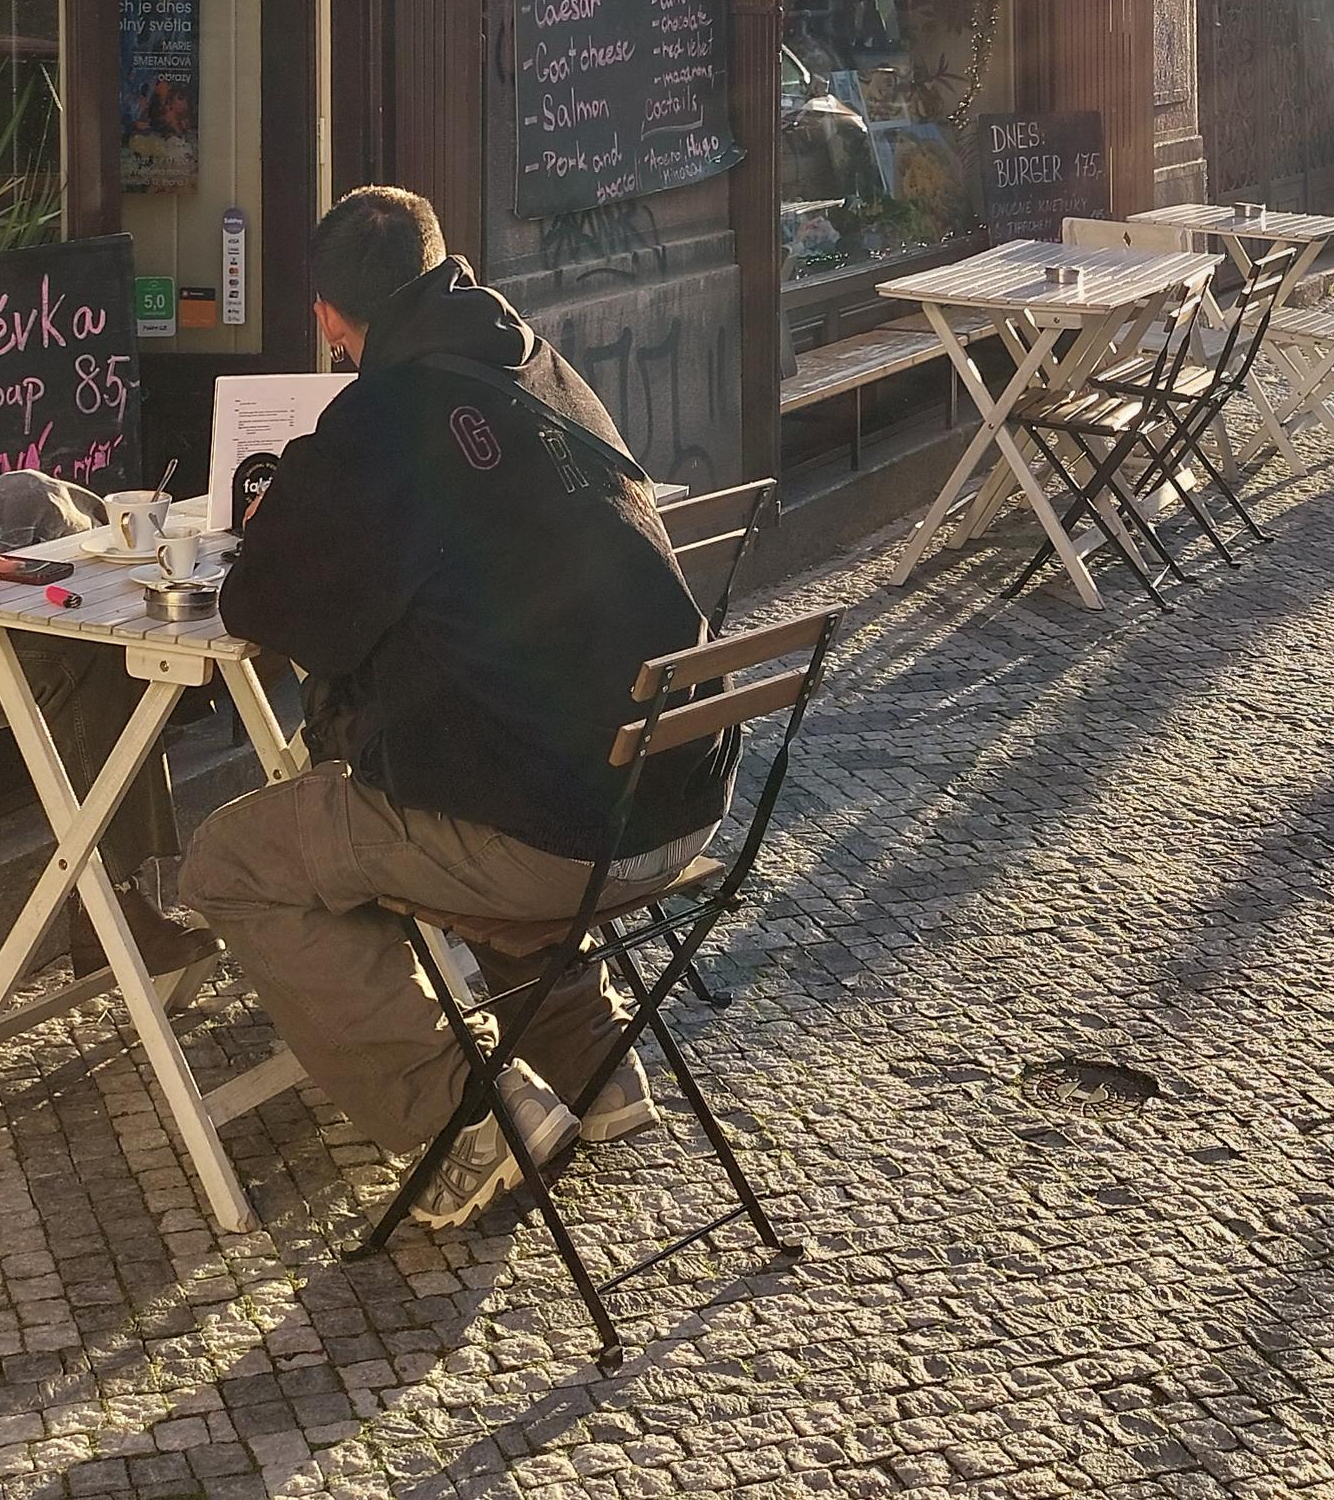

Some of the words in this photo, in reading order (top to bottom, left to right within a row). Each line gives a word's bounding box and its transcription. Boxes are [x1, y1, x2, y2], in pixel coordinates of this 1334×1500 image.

[156, 0, 192, 14] dnes
[162, 41, 192, 51] MARIE
[543, 87, 610, 132] Salmon
[993, 154, 1063, 189] BURGER
